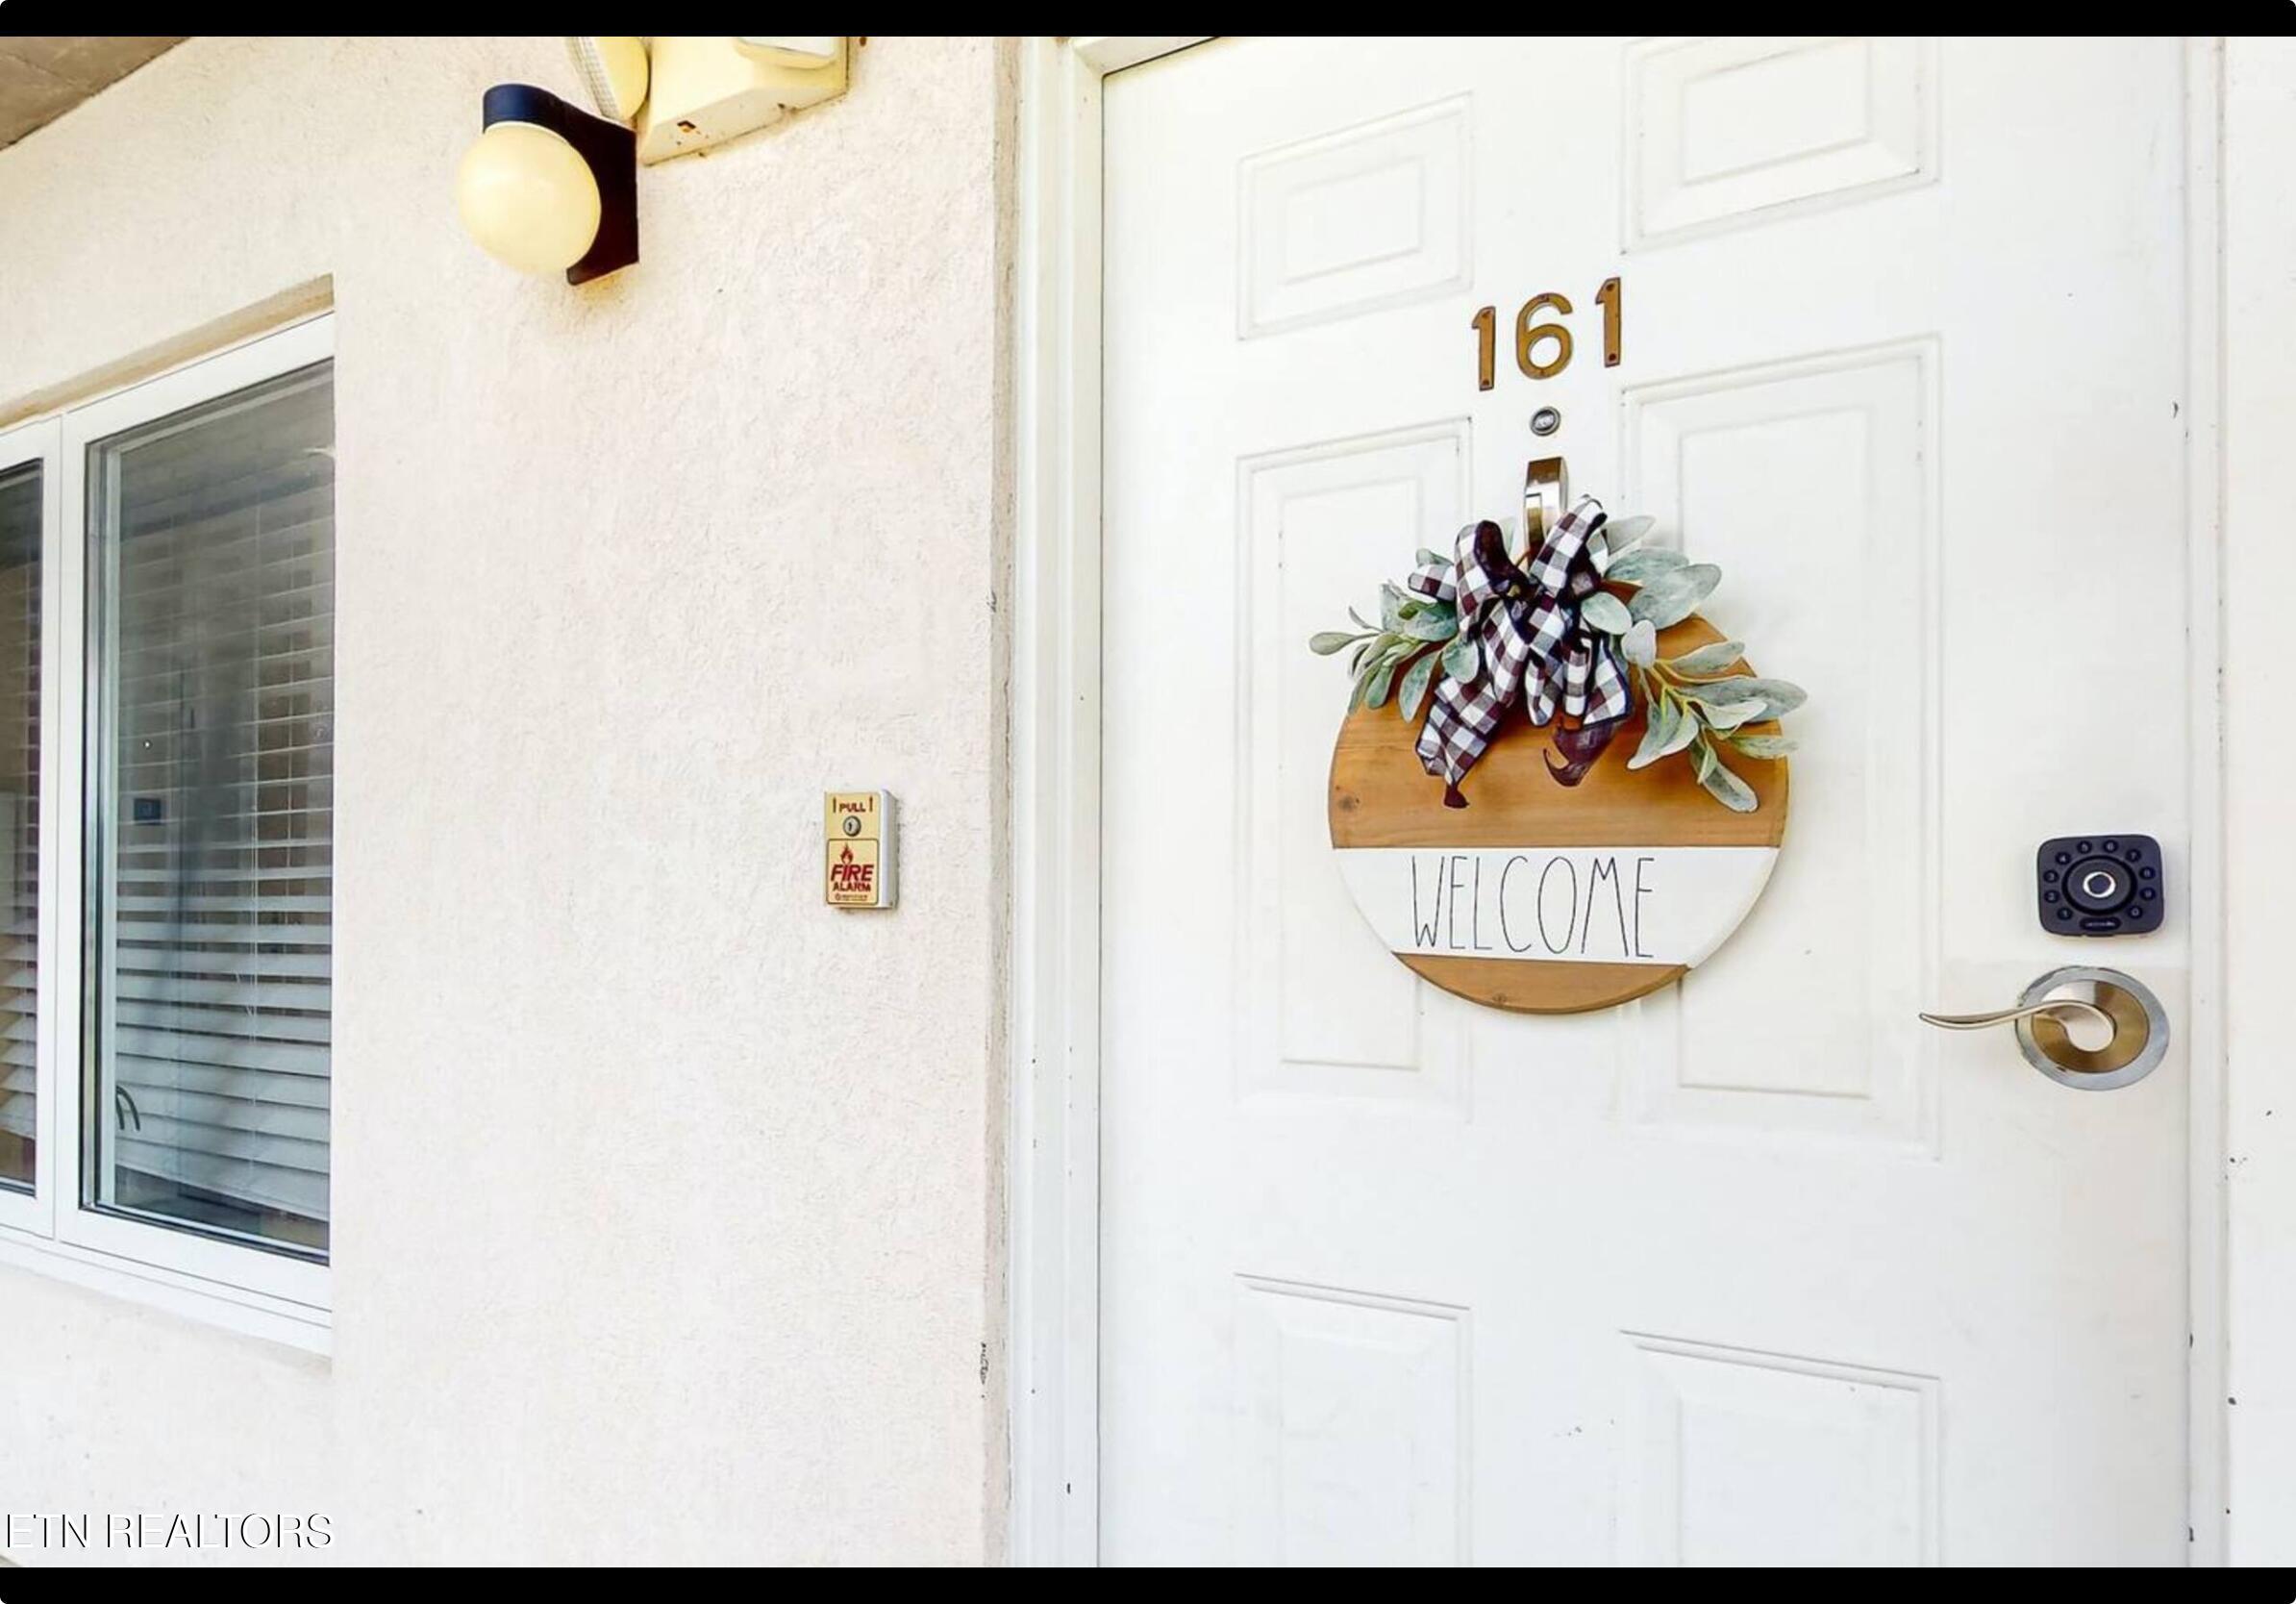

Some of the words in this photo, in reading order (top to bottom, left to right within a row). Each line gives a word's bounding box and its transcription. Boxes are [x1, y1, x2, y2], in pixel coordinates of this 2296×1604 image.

[1472, 277, 1622, 392] 161
[839, 803, 865, 813] PULL
[831, 865, 874, 881] FIRE
[833, 882, 871, 891] ALARM
[1411, 855, 1655, 958] WELCOME
